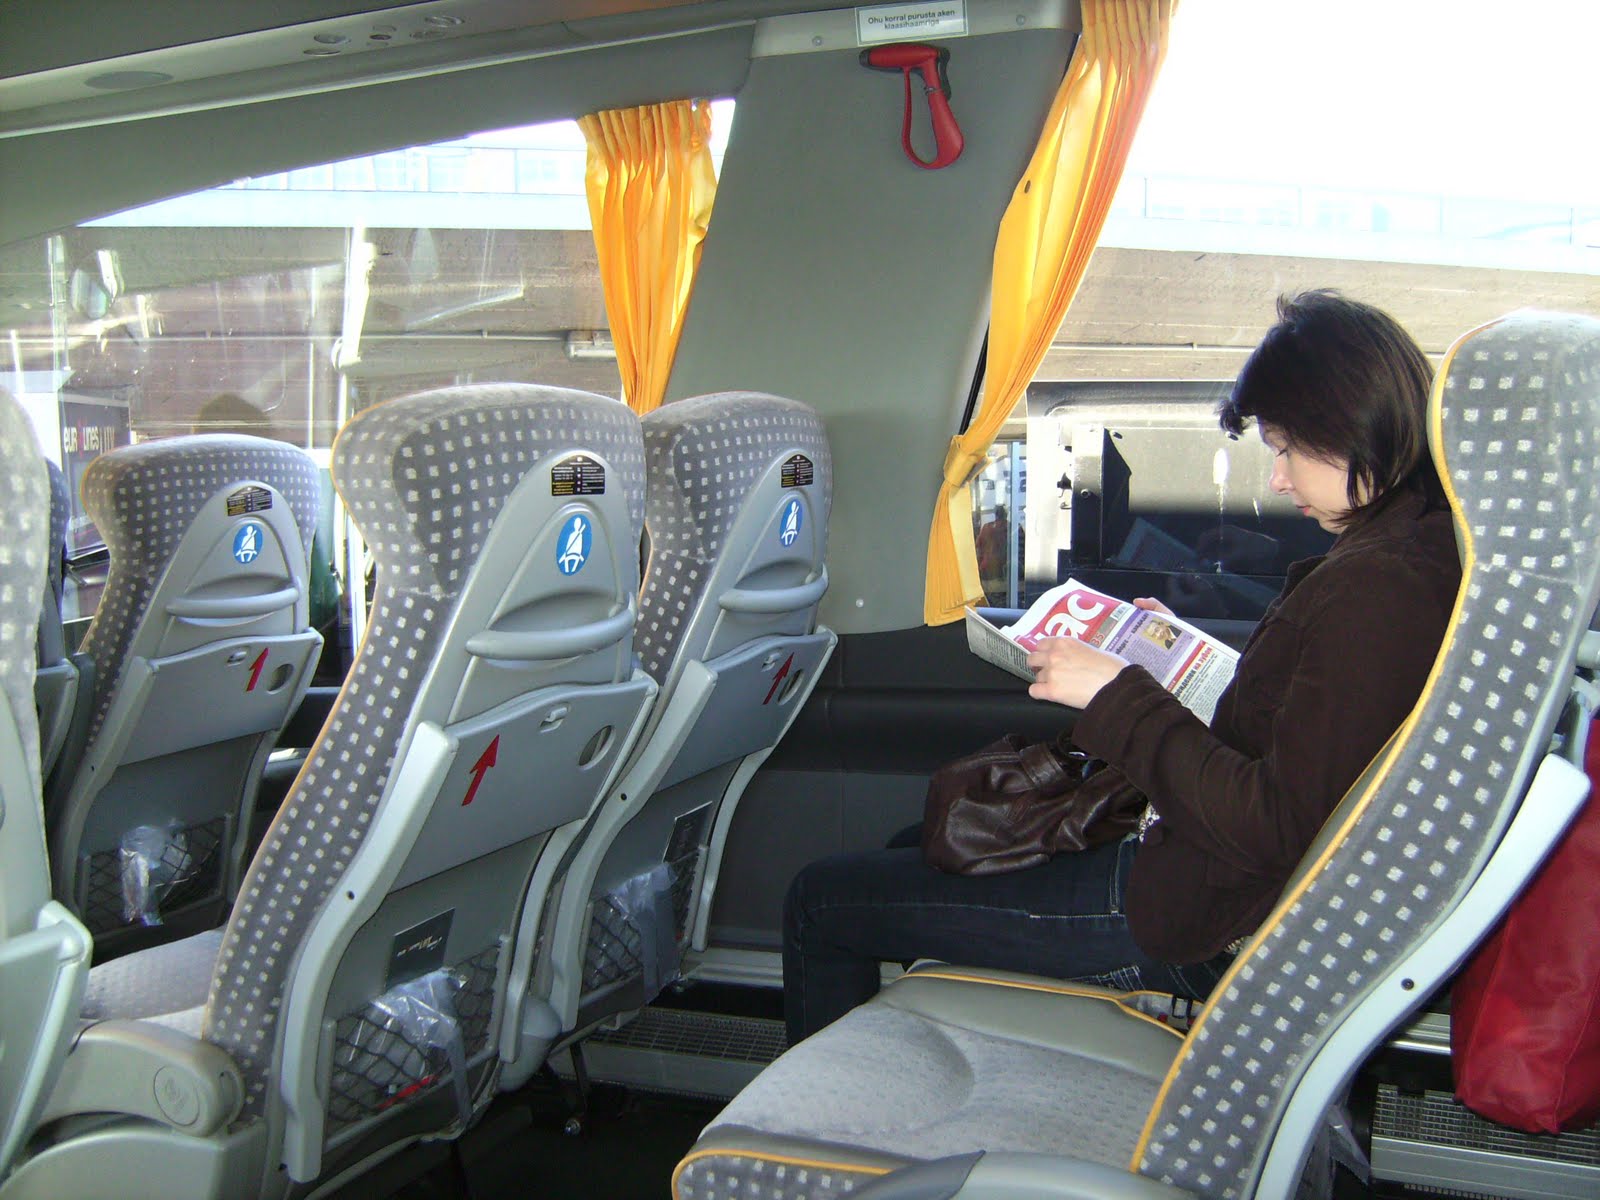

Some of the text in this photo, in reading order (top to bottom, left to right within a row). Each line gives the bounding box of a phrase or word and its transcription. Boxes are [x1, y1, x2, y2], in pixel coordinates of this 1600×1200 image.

[884, 14, 906, 22] korral
[907, 11, 936, 21] purusta
[937, 9, 955, 17] aken
